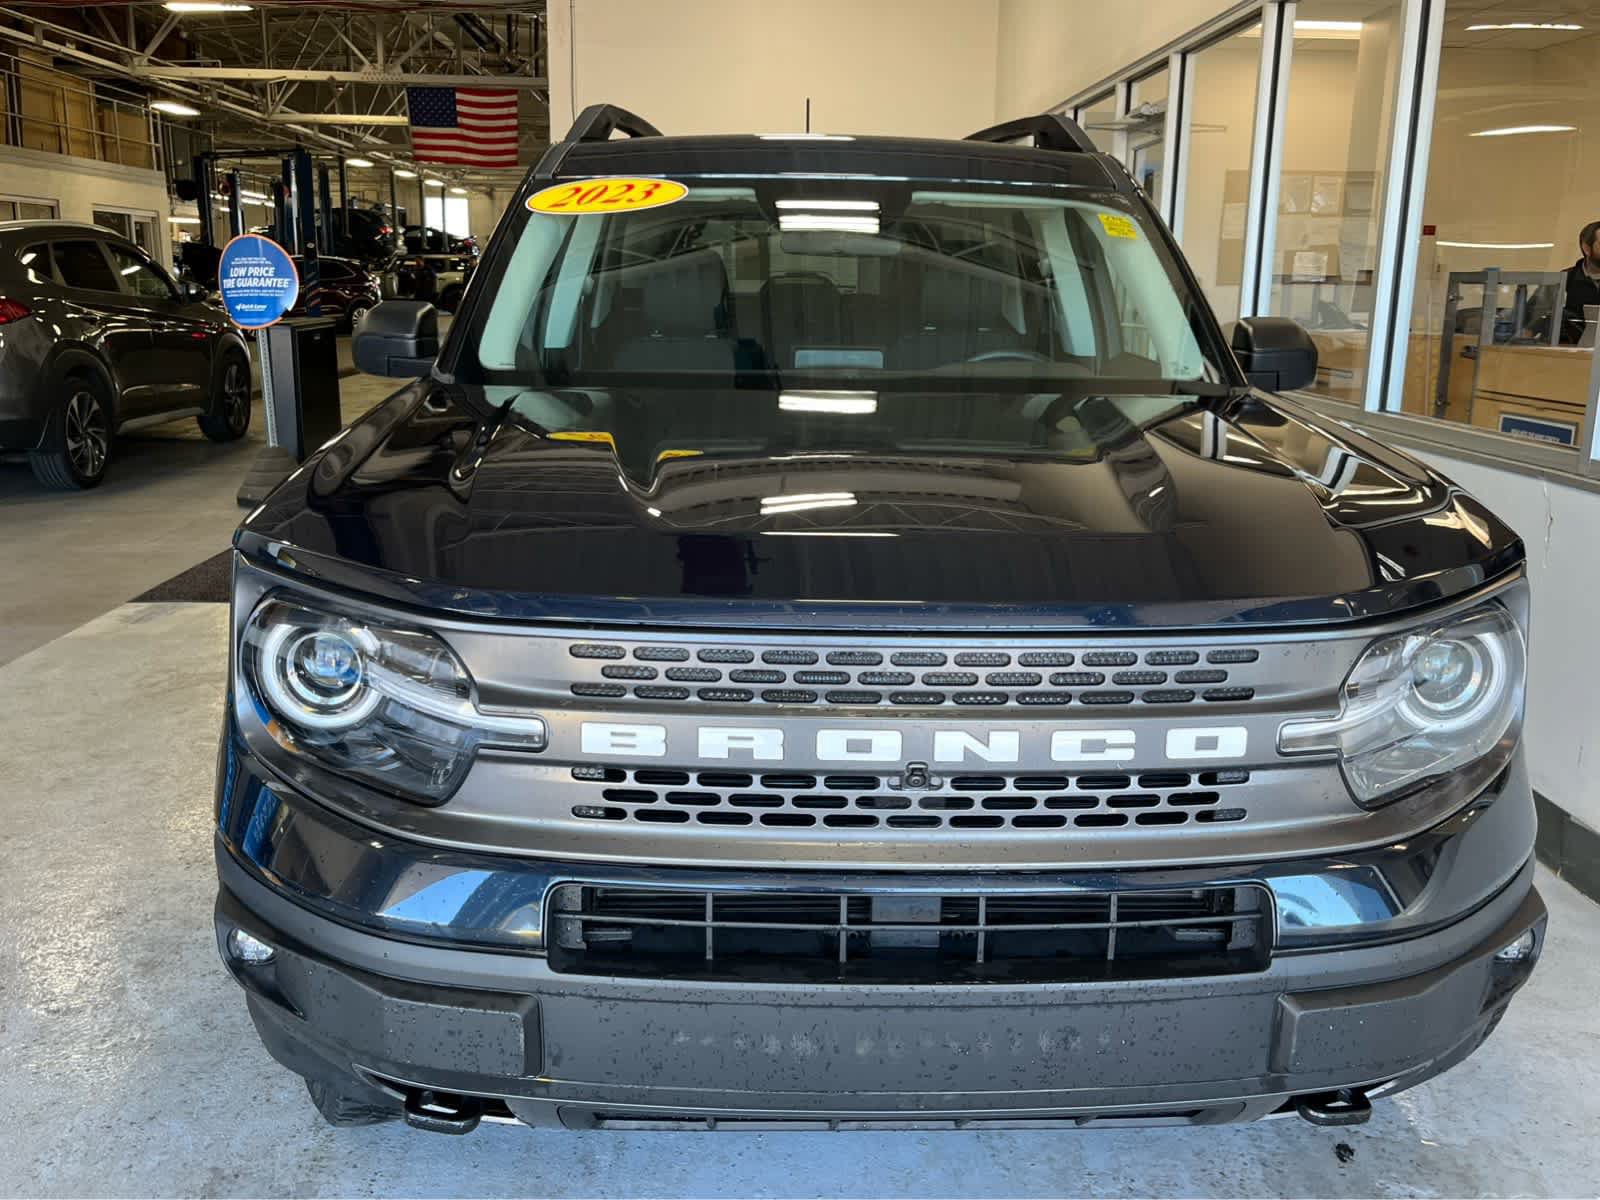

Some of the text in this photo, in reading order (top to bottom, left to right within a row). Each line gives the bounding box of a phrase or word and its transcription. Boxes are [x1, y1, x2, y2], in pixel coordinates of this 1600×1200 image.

[548, 183, 661, 208] 2023
[230, 266, 275, 277] LOW PRICE
[236, 277, 290, 288] GUARANTEE
[581, 722, 1248, 763] BRONCO
